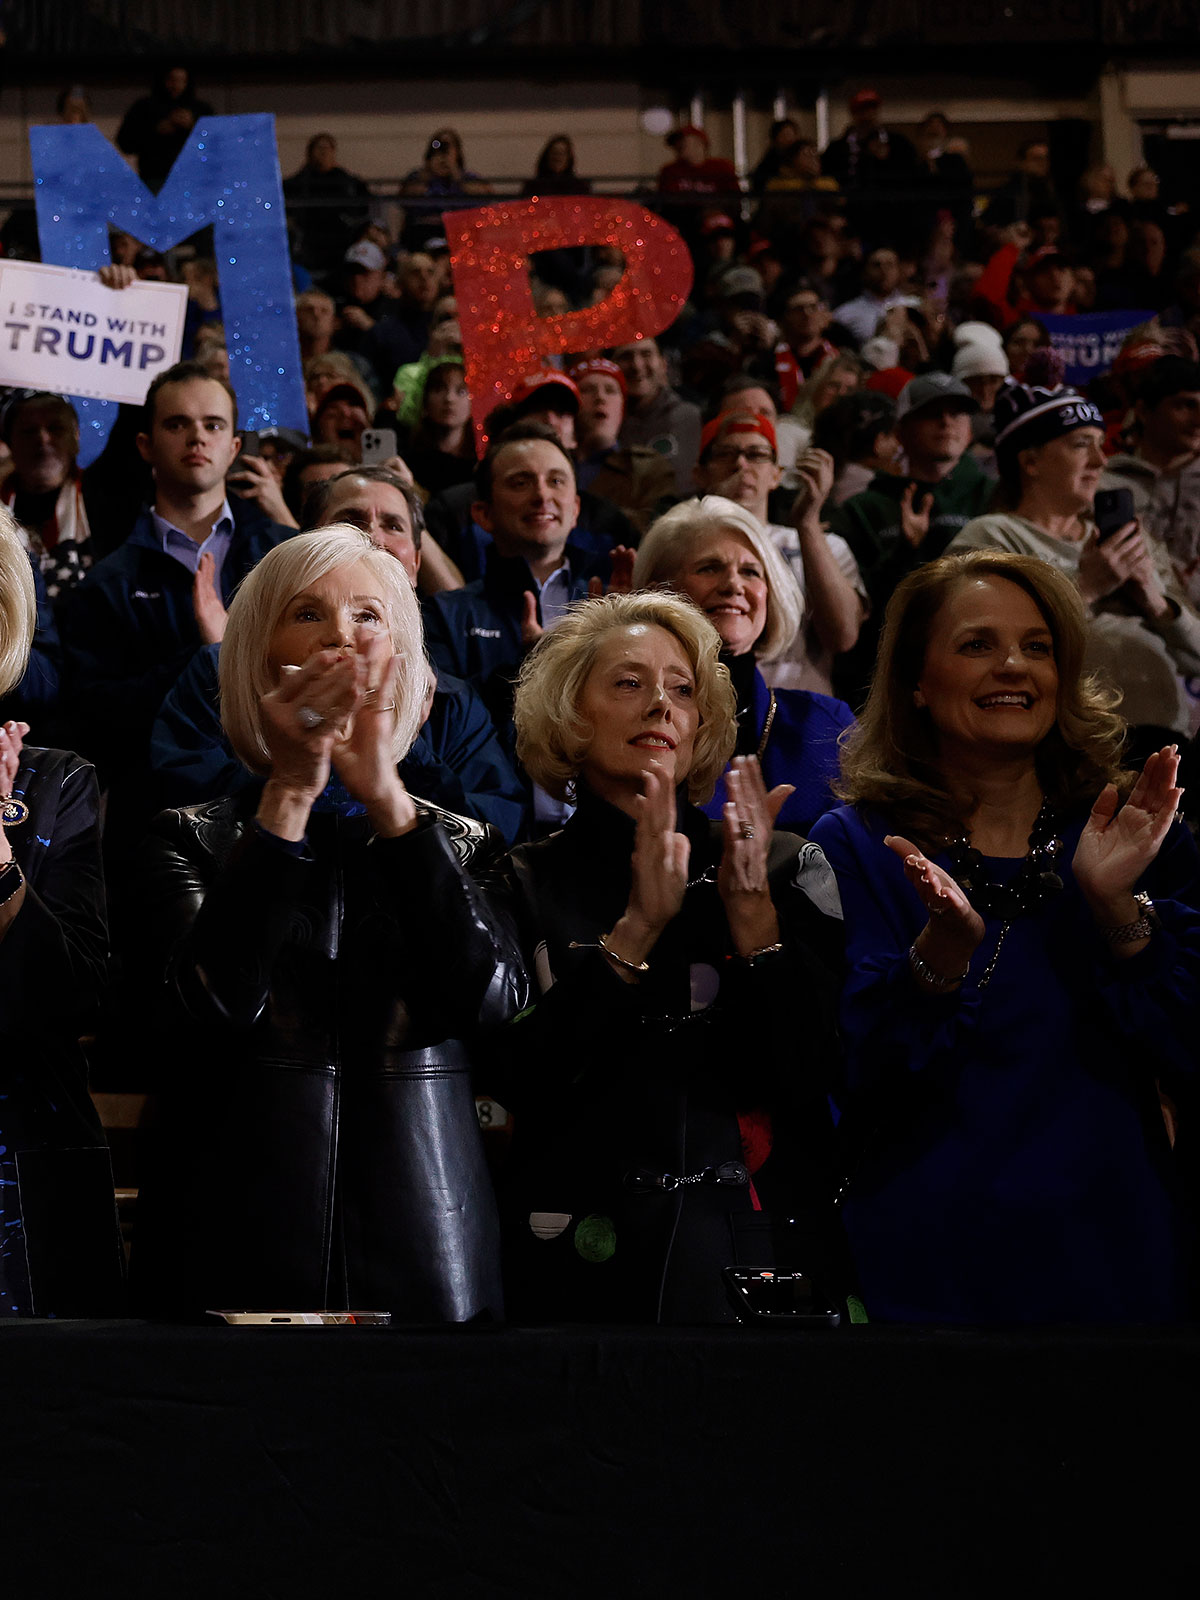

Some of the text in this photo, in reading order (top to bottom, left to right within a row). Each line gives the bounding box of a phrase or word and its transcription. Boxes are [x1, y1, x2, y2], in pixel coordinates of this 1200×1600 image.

[8, 302, 166, 337] I STAND WITH
[4, 322, 166, 370] TRUMP
